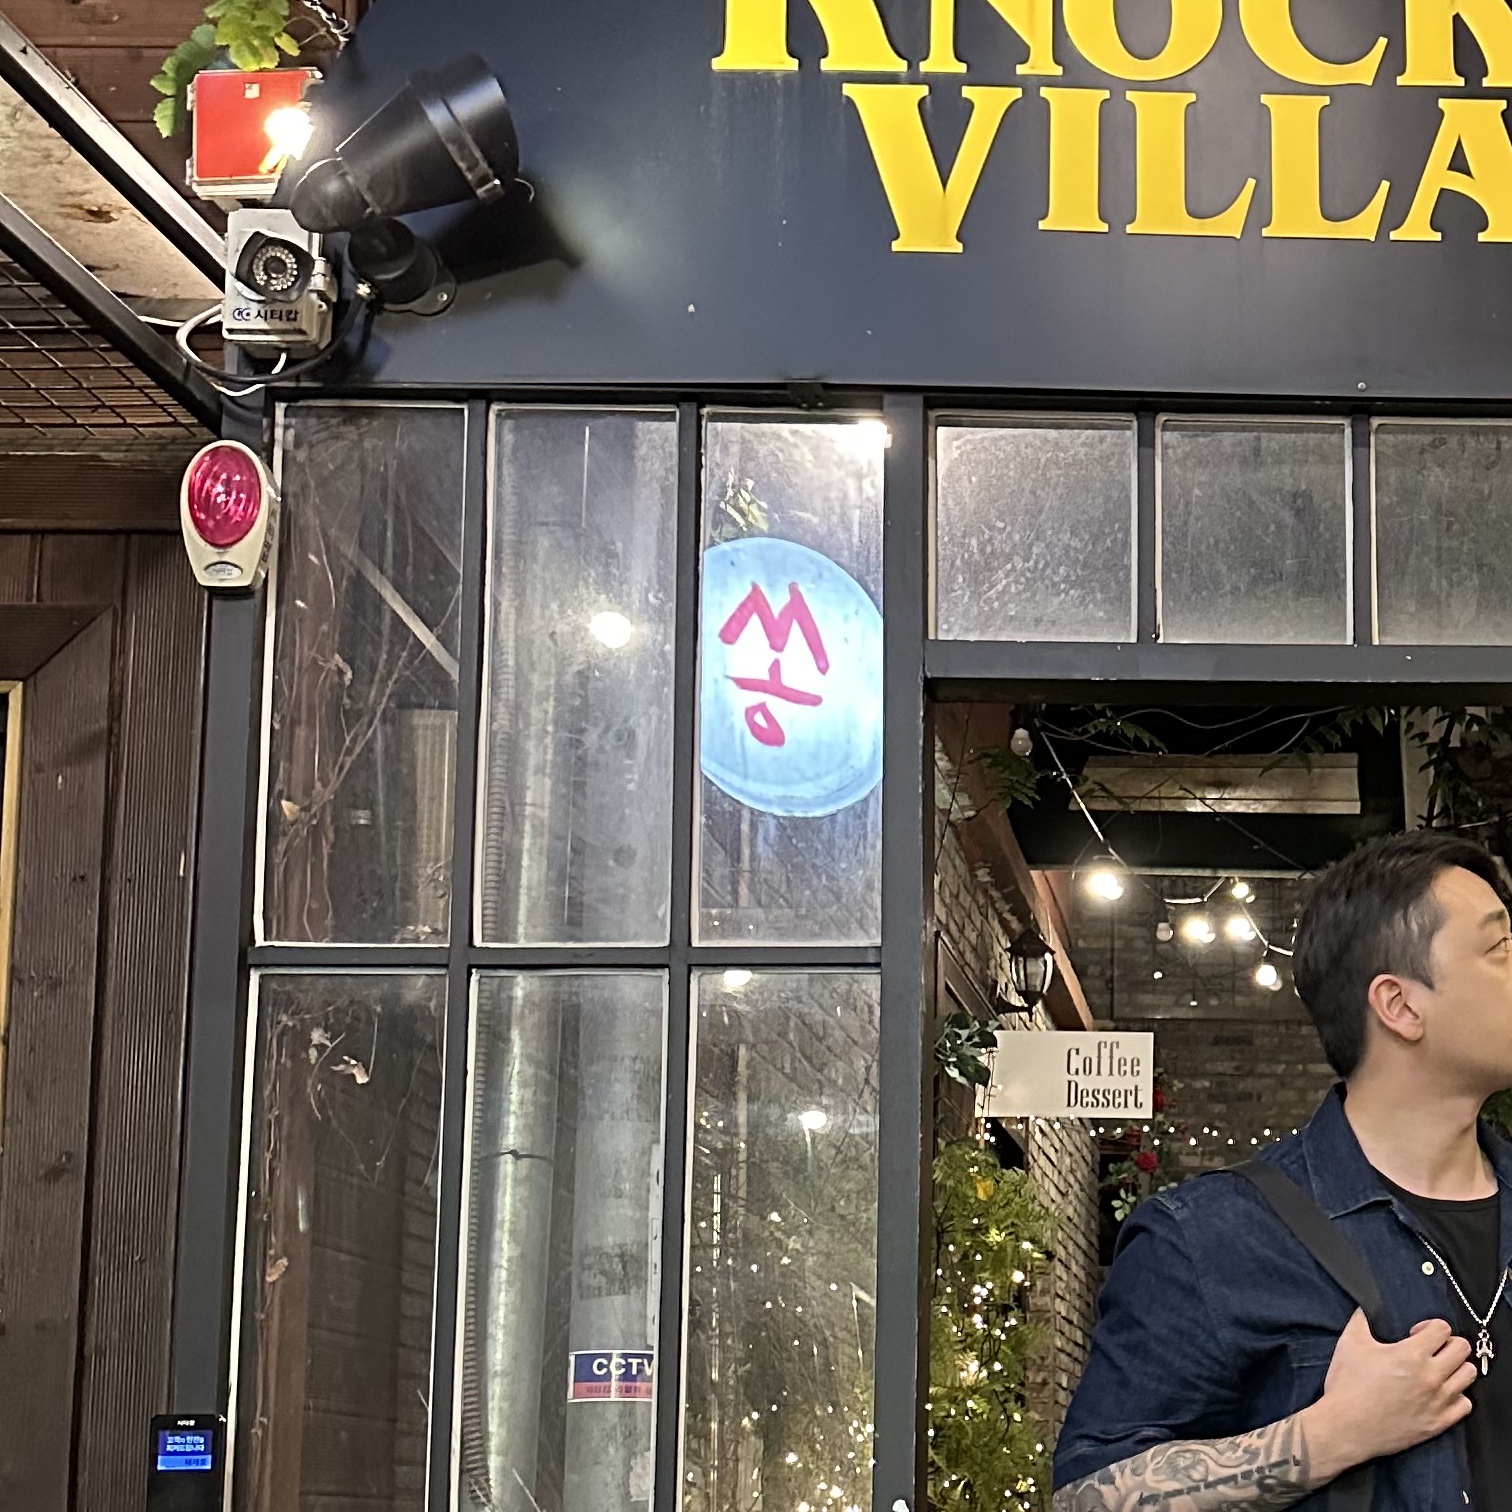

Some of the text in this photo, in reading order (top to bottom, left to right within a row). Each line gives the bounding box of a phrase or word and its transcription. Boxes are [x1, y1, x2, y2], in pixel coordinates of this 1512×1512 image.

[1066, 1040, 1141, 1077] Coffee
[1066, 1080, 1143, 1110] Dessert
[592, 1357, 654, 1376] CCTV
